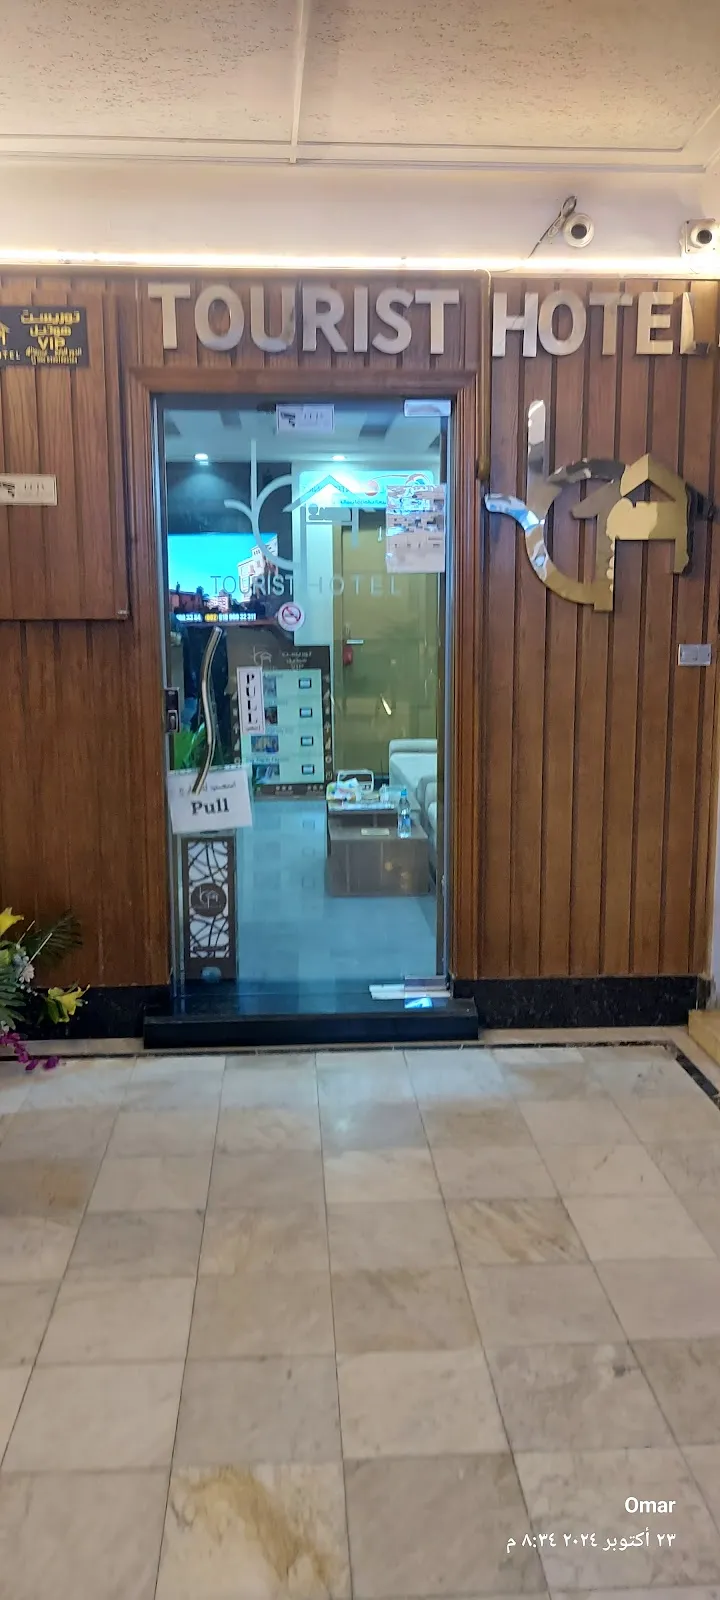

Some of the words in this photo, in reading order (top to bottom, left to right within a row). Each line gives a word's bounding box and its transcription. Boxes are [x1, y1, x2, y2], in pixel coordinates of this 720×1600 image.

[21, 309, 80, 325] توريست
[147, 283, 460, 354] TOURIST
[492, 290, 710, 358] HOTEL
[30, 324, 71, 337] هوتيل
[38, 336, 66, 350] VIP
[210, 575, 293, 596] TOURIST
[309, 574, 401, 596] HOTEL
[246, 673, 258, 724] PULL
[191, 798, 230, 816] Pull
